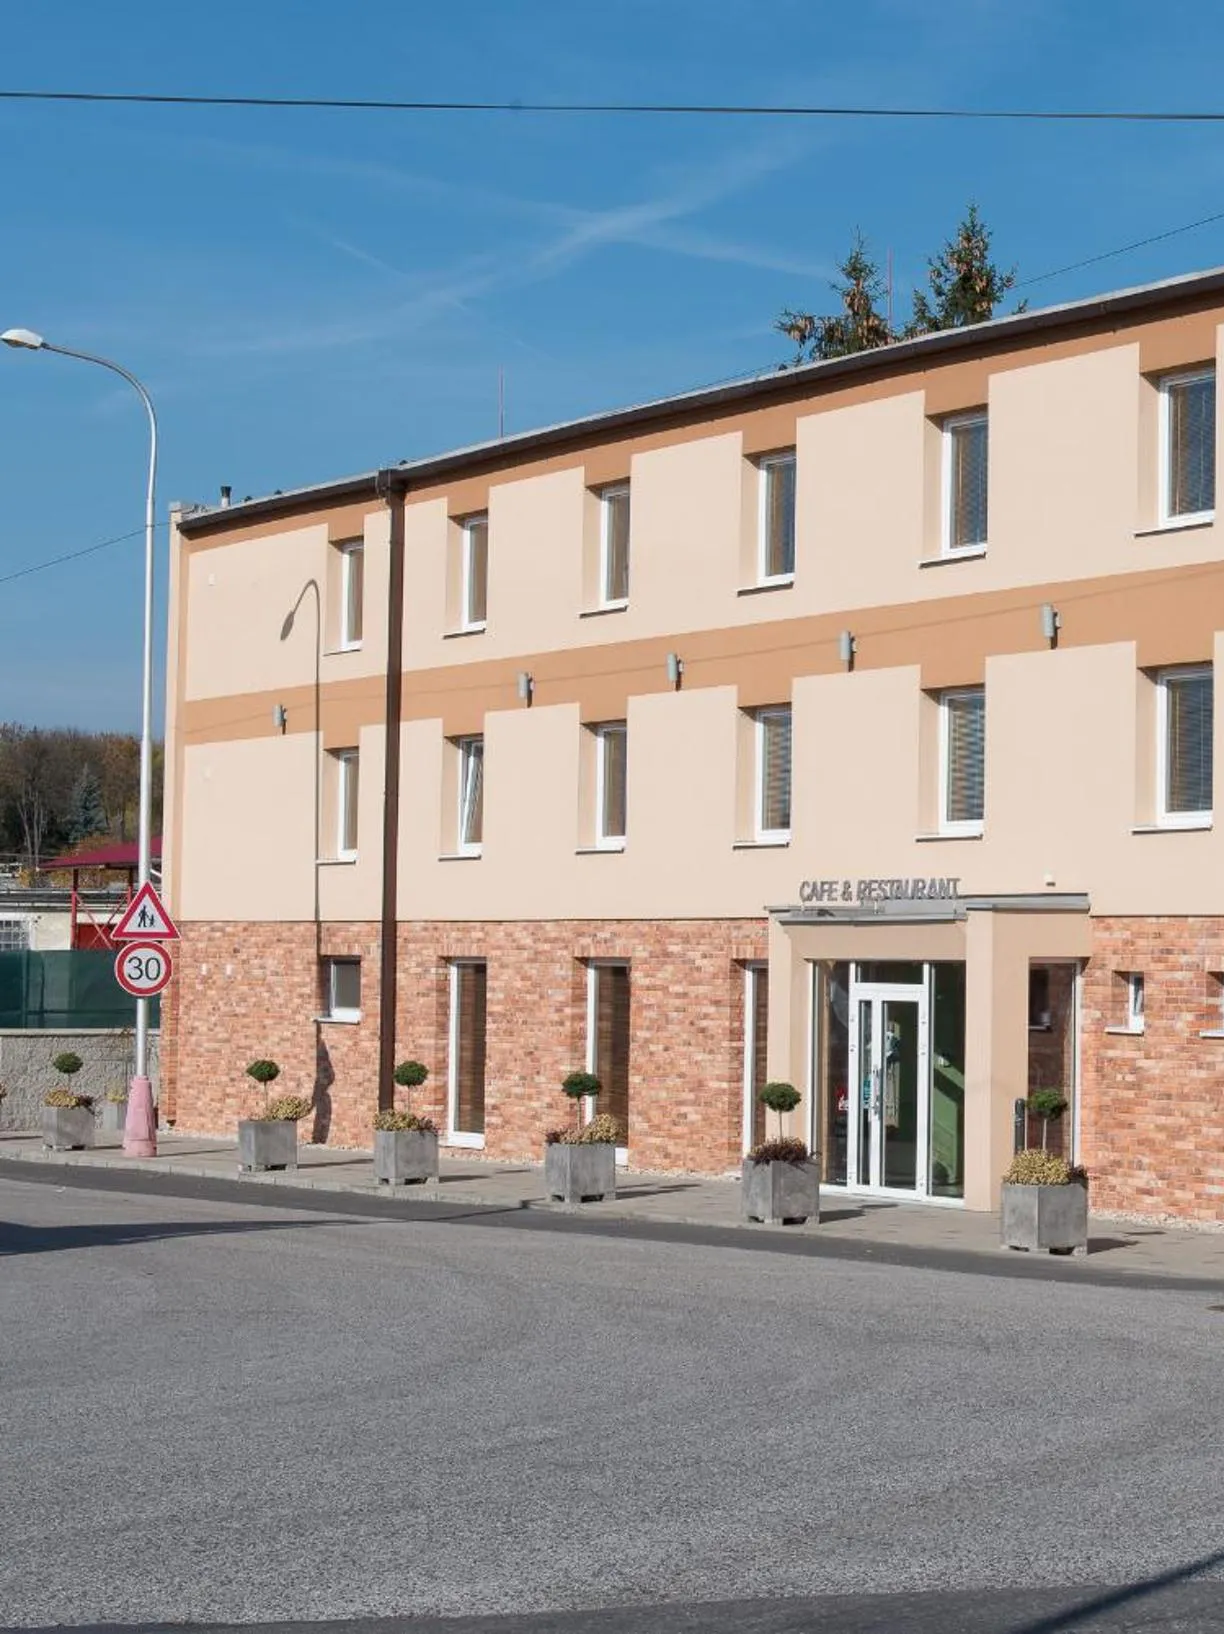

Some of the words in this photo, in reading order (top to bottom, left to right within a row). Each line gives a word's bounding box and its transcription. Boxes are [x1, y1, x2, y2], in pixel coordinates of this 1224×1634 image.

[800, 880, 839, 901] CAFE
[842, 880, 852, 901] &
[857, 878, 960, 900] RESTAURANT
[128, 957, 160, 981] 30
